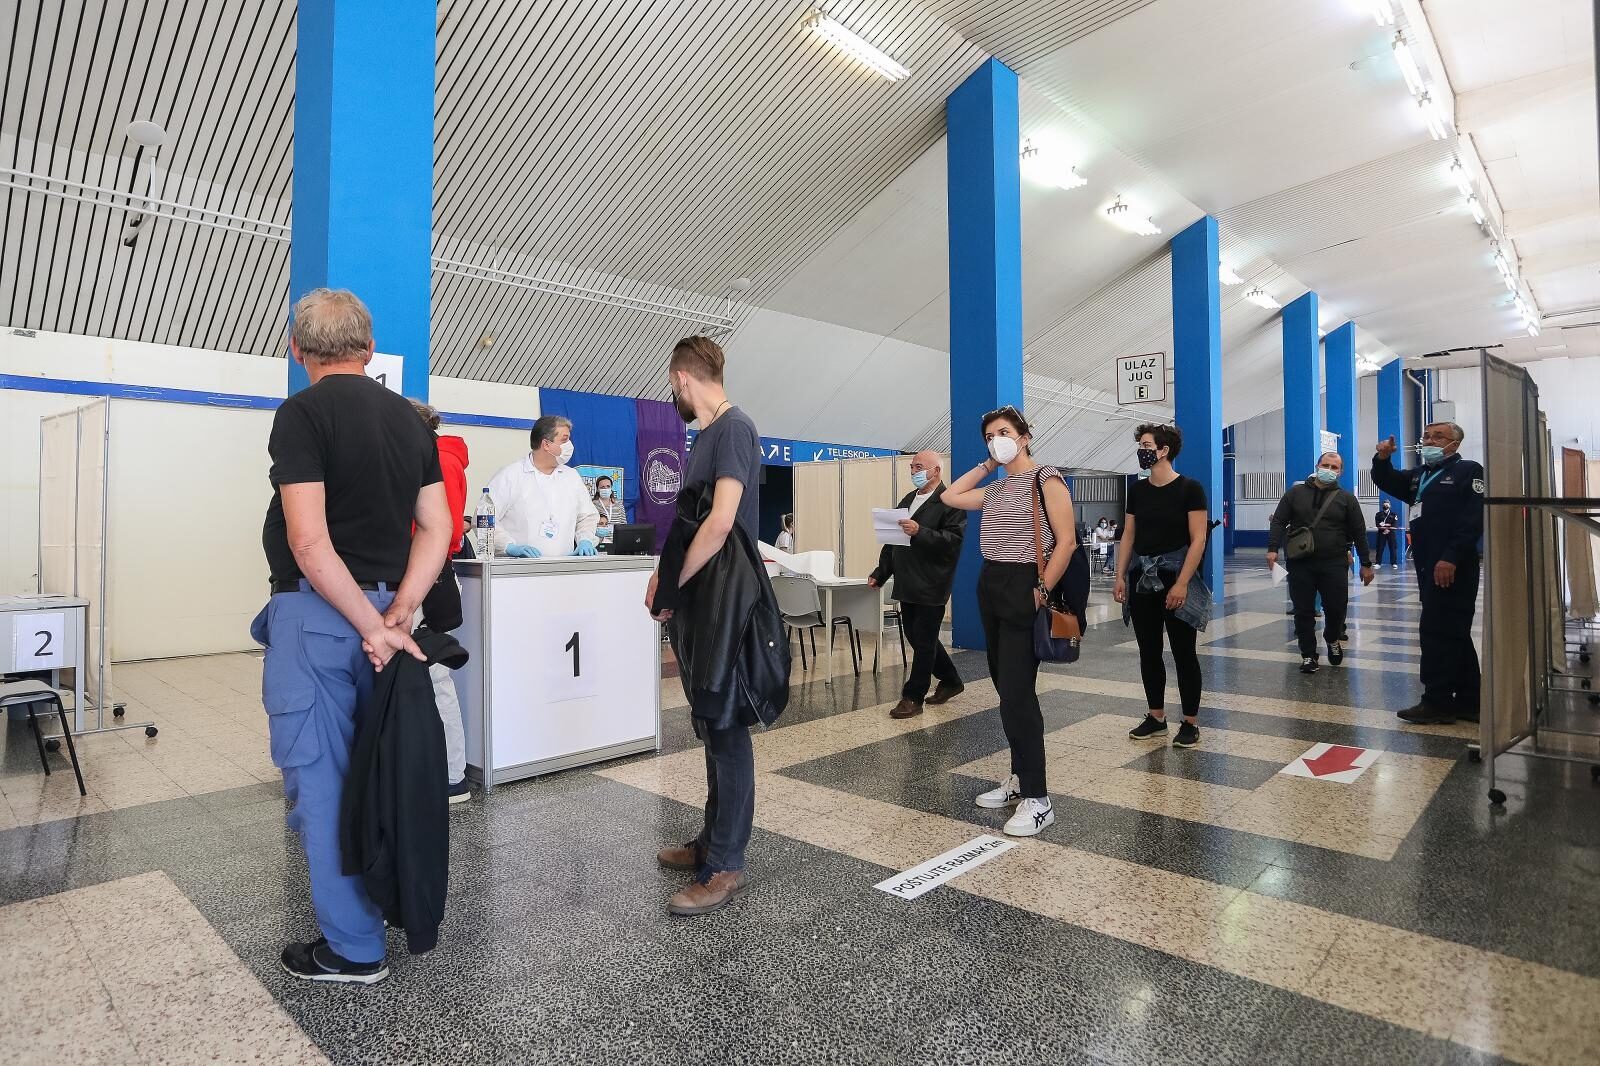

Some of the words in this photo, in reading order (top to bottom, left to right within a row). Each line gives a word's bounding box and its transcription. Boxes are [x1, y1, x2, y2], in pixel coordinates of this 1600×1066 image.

[1124, 358, 1156, 370] ULAZ
[1128, 370, 1153, 382] JUG
[1138, 386, 1145, 398] E
[783, 446, 791, 462] E
[827, 447, 870, 459] TELESKOP
[34, 630, 54, 657] 2
[565, 631, 580, 678] 1
[892, 864, 953, 893] POŠTUJTE
[949, 845, 990, 868] RAZMAK
